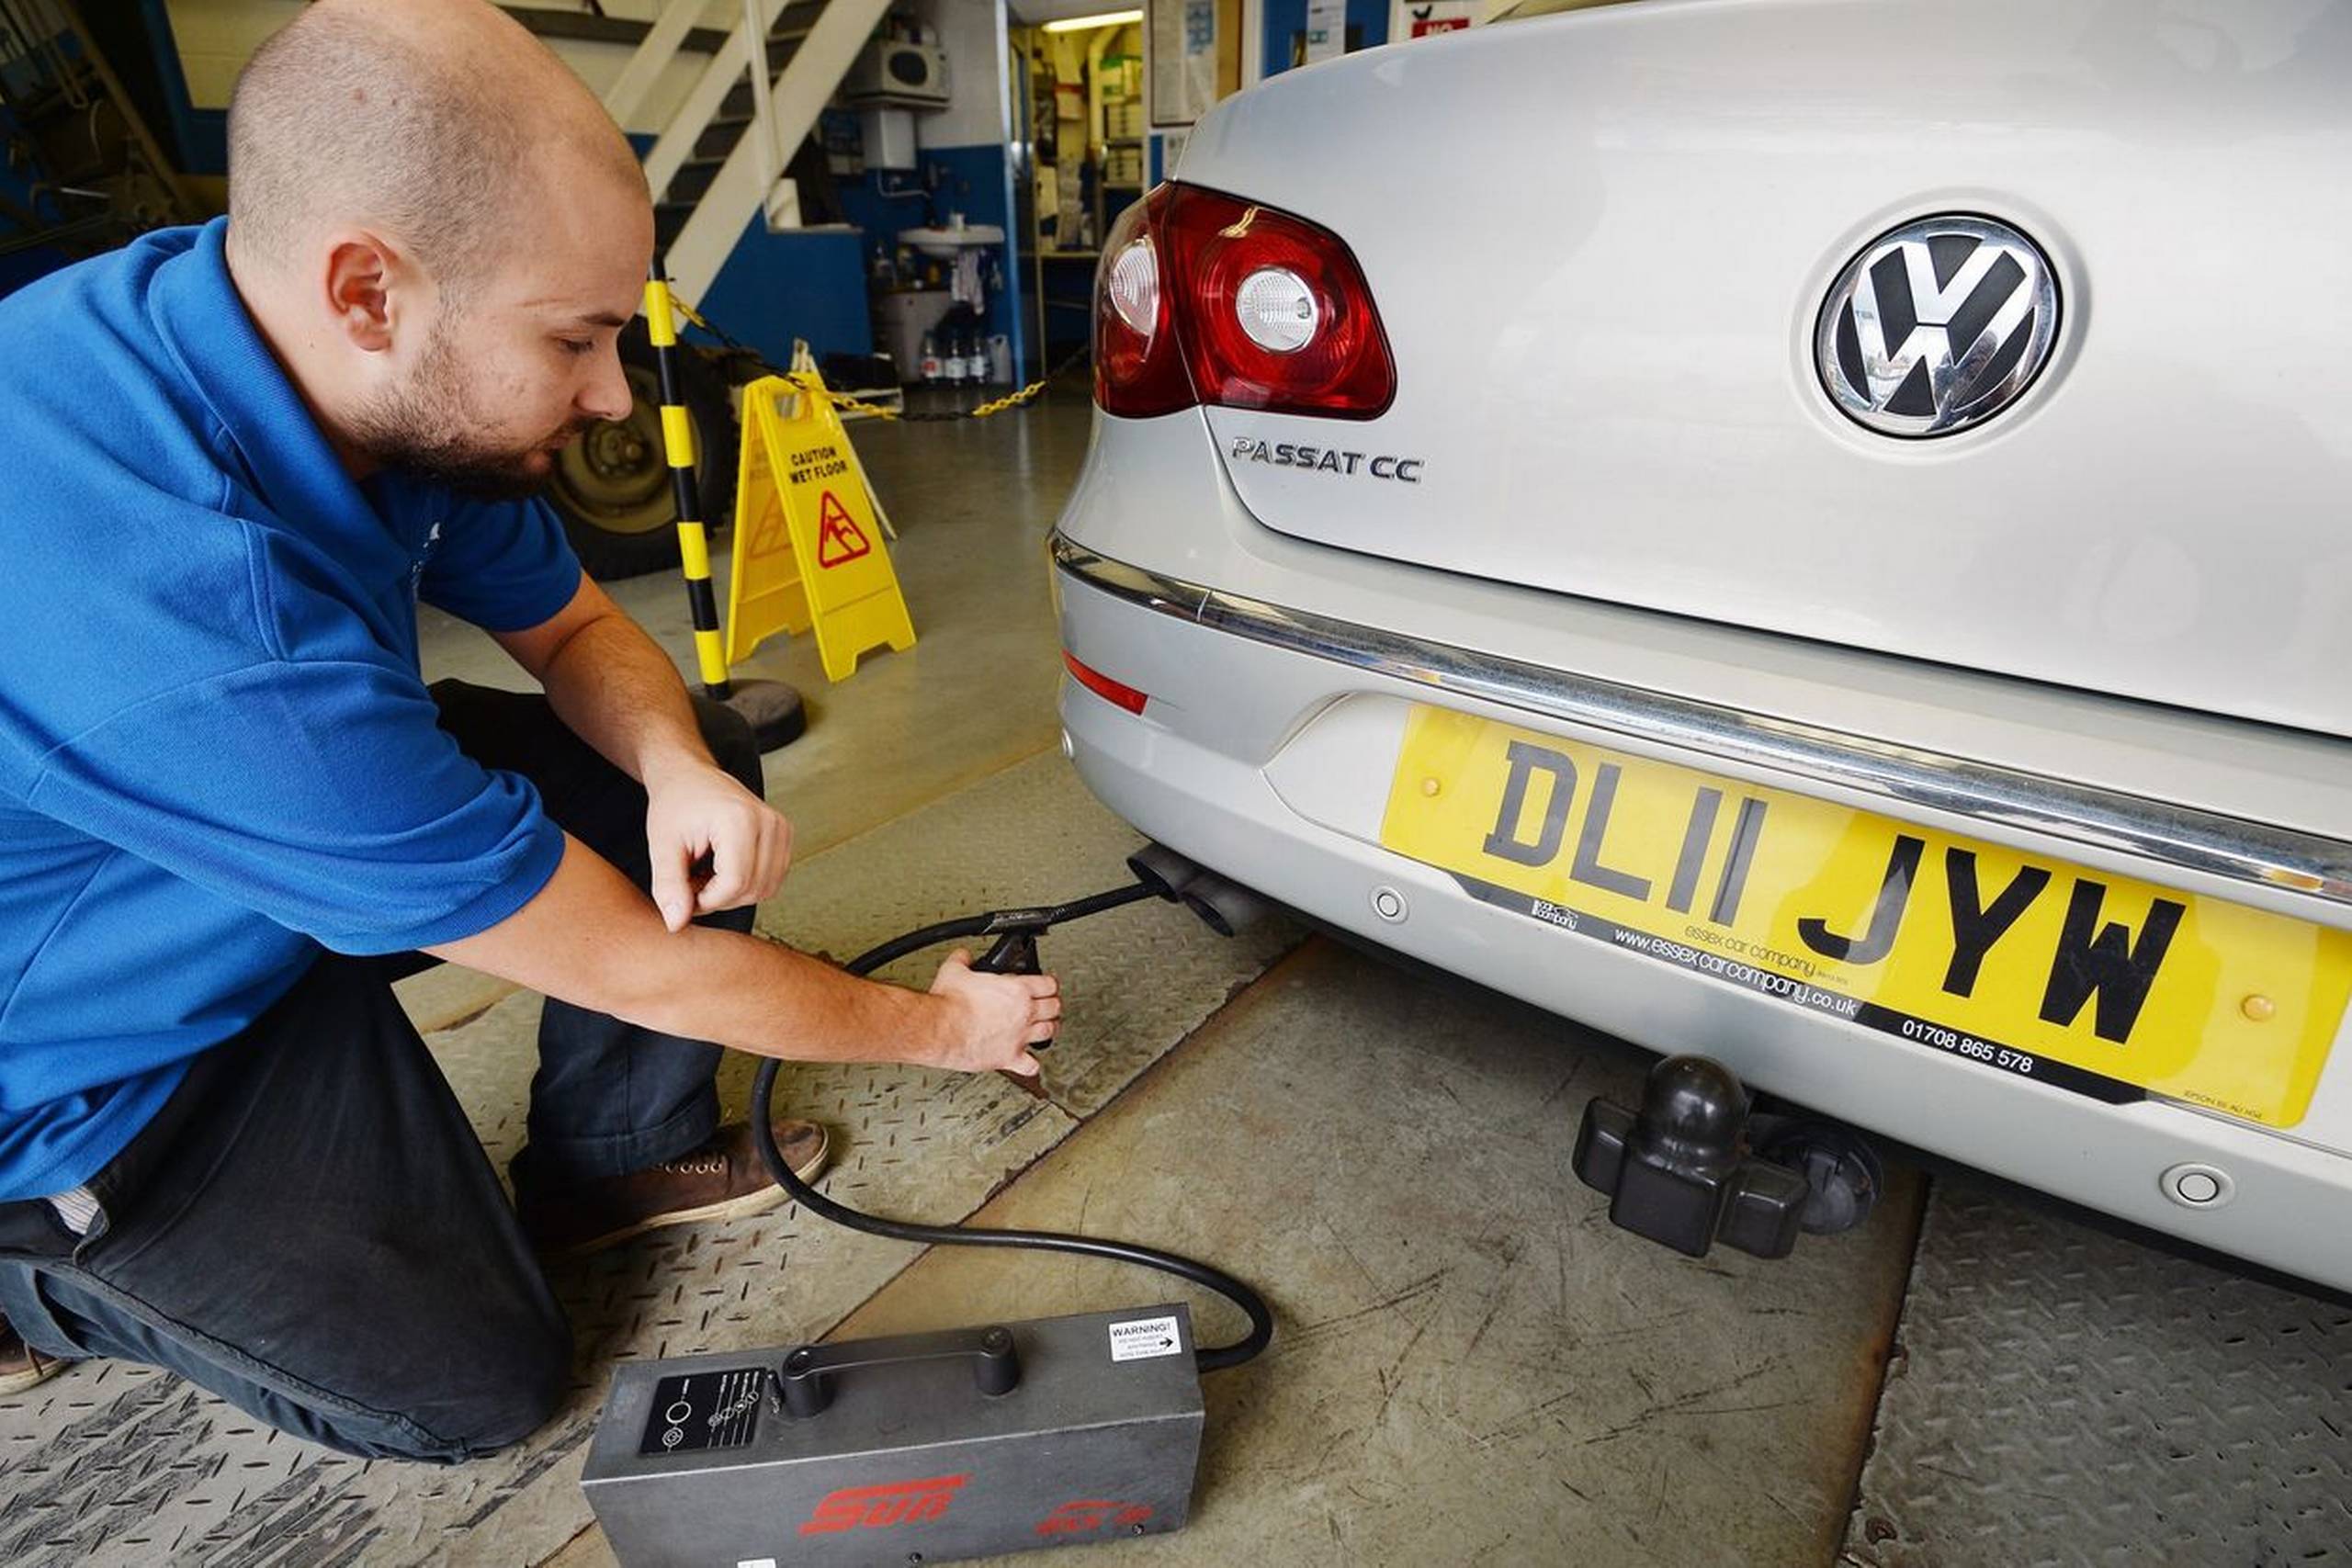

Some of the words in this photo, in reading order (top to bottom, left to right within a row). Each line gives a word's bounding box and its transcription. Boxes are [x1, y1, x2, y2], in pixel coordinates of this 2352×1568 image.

[789, 468, 812, 484] WET
[814, 460, 847, 479] FLOOR
[791, 446, 836, 467] CAUTION
[1232, 436, 1364, 475] PASSAT
[1370, 455, 1424, 483] CC
[1482, 739, 1769, 928] DL11
[1797, 834, 2187, 1044] JYW
[1614, 928, 1858, 1016] www.essexcarcompany.co.uk
[1684, 924, 1724, 945] essex
[1725, 934, 1748, 953] car
[1749, 945, 1815, 977] company
[1902, 1020, 1958, 1049] 01708
[1960, 1038, 1996, 1061] 865
[1997, 1050, 2033, 1073] 578
[1113, 1322, 1170, 1337] WARNING!
